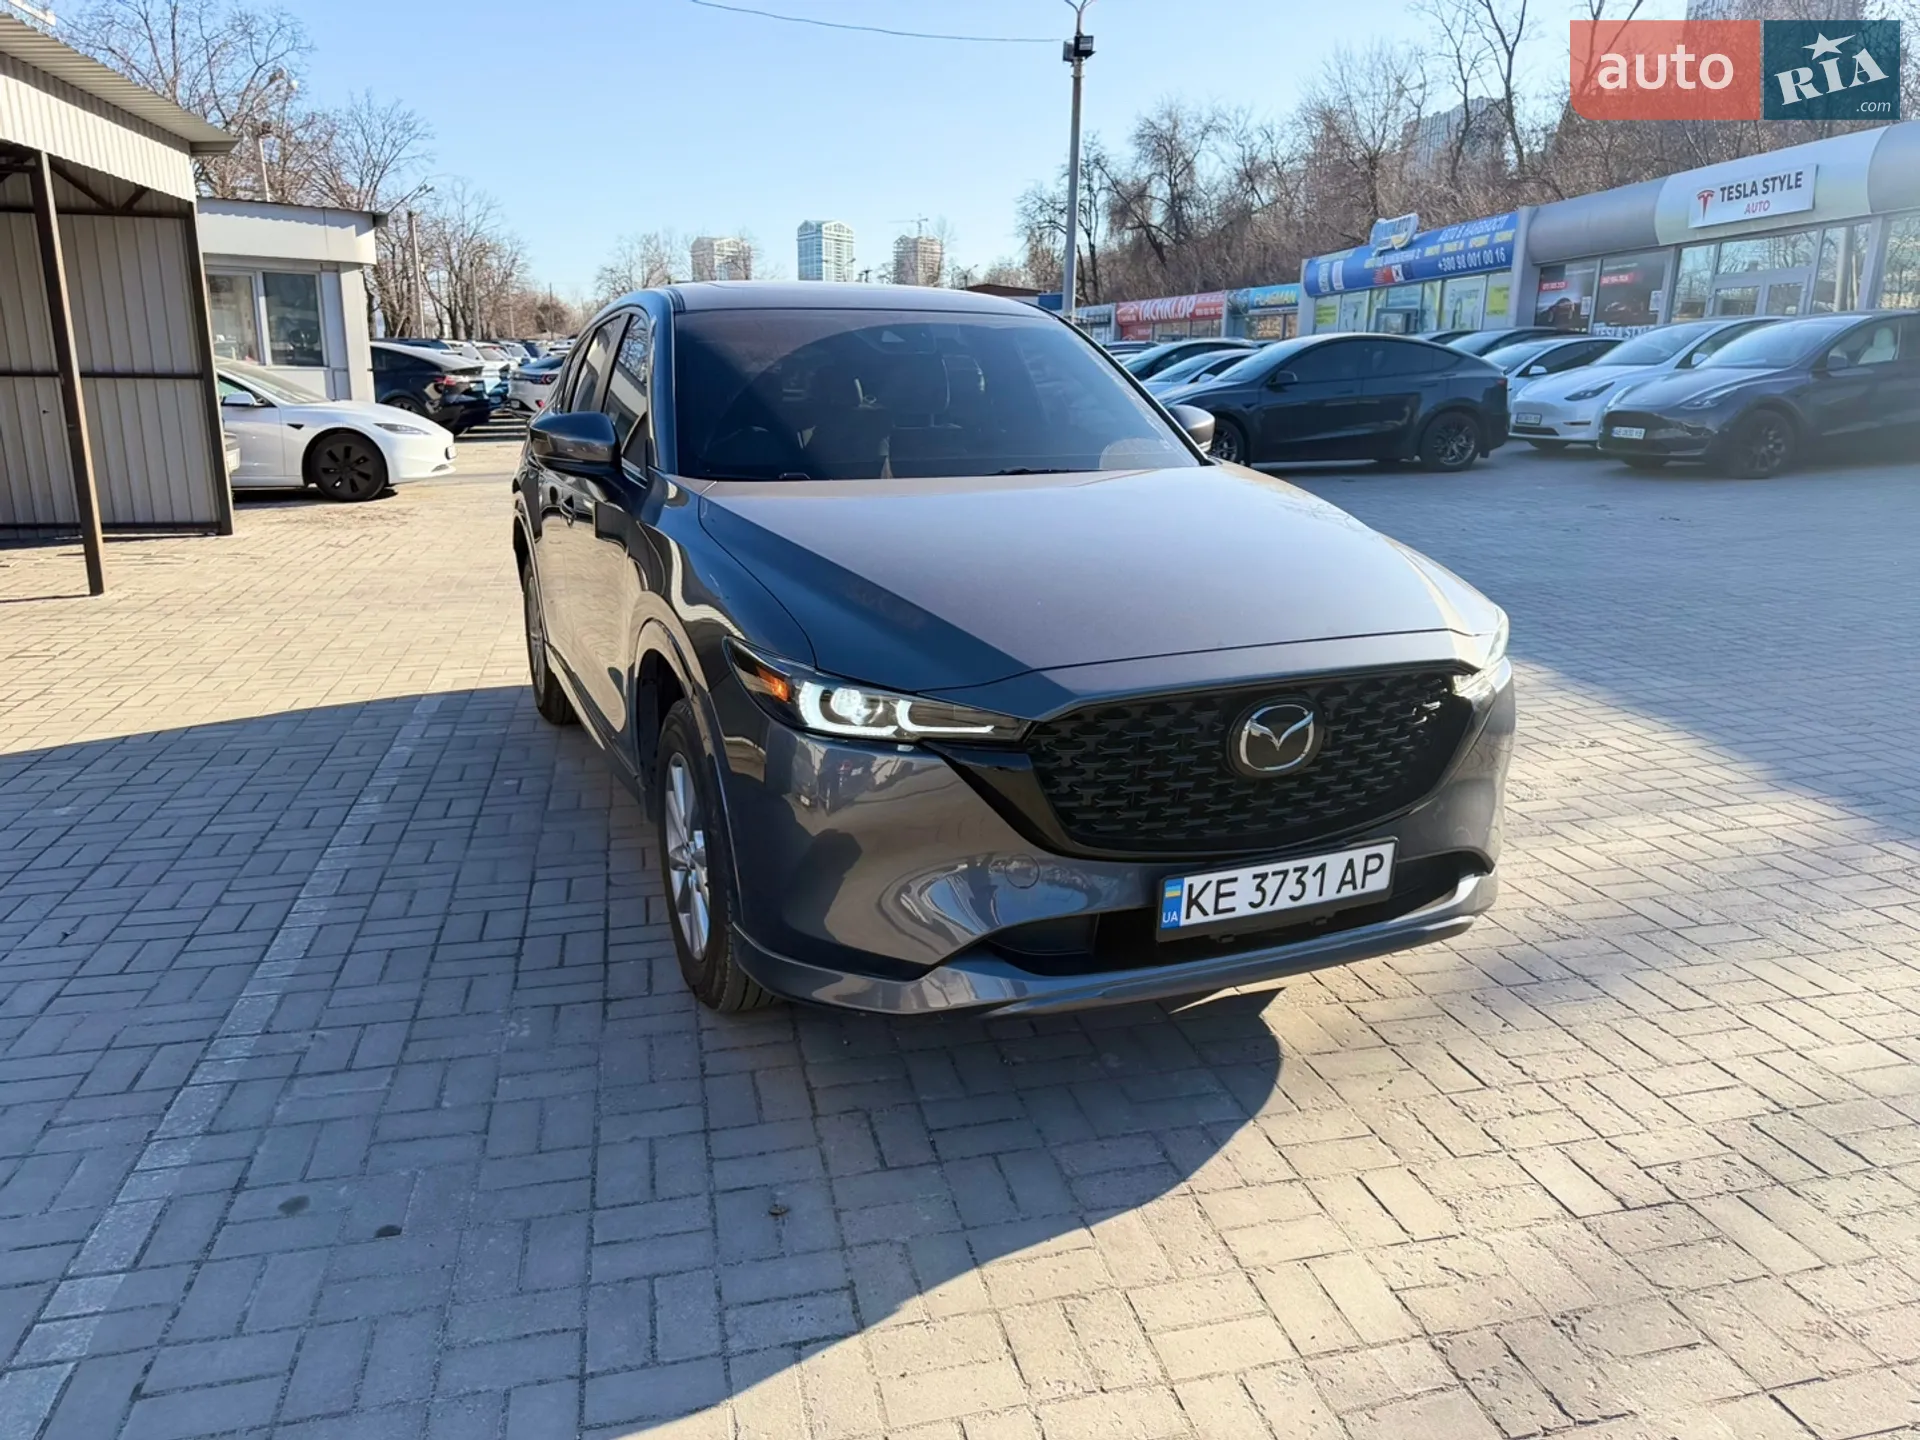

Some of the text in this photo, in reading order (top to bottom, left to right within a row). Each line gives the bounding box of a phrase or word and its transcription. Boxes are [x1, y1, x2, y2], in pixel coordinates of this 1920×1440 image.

[1720, 171, 1803, 203] TESLA STYLE
[1744, 200, 1771, 215] AUTO
[1482, 249, 1494, 265] 00
[1185, 853, 1385, 920] KE 3731 AP
[1162, 912, 1179, 923] UA
